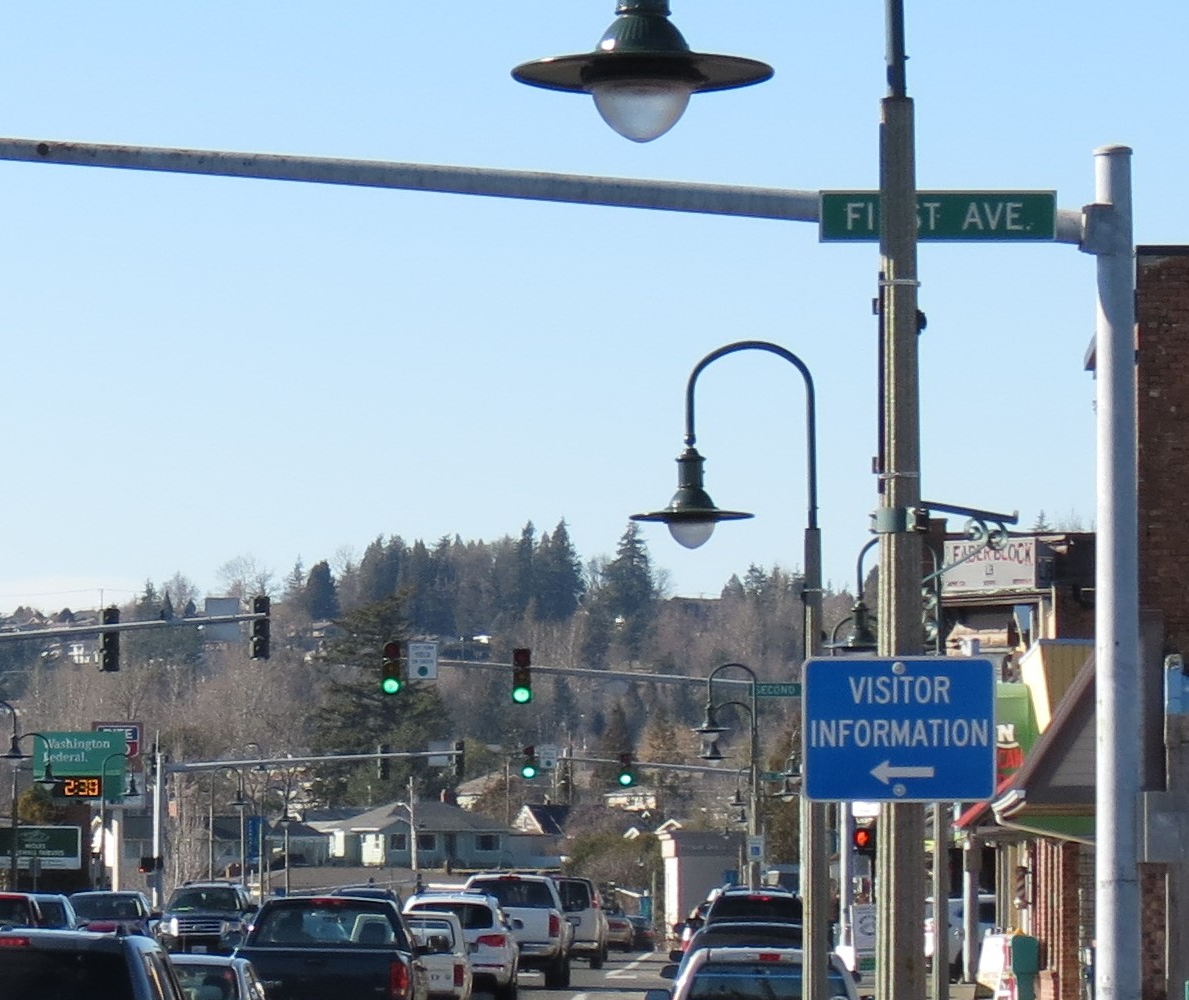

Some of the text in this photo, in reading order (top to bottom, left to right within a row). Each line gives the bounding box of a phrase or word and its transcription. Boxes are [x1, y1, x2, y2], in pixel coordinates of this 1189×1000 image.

[845, 202, 1032, 230] FIT AVE.
[848, 676, 951, 705] VISITOR
[43, 738, 111, 751] Washington
[811, 719, 989, 748] INFORMATION
